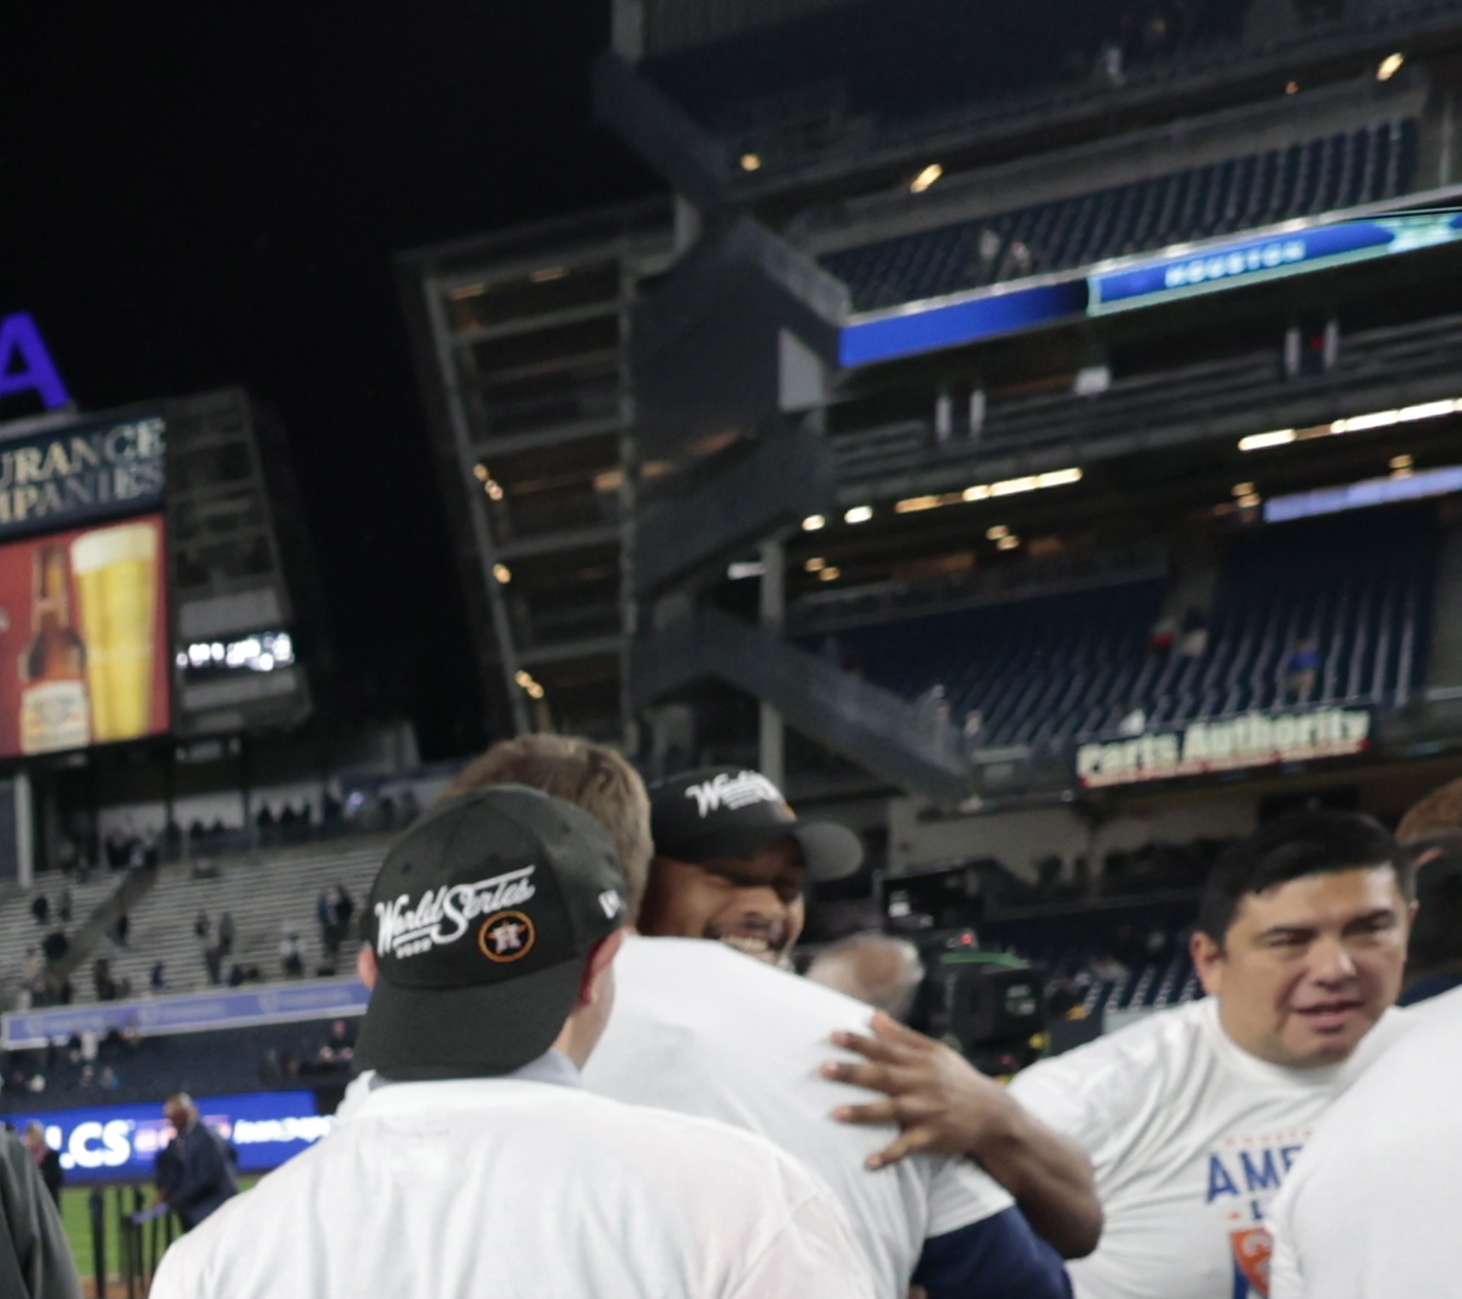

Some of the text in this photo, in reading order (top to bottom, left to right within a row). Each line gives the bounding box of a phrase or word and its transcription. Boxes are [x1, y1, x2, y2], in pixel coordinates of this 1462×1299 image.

[1165, 239, 1306, 288] HOUSTON
[1077, 707, 1370, 776] Parts Authority
[374, 864, 537, 958] World Series
